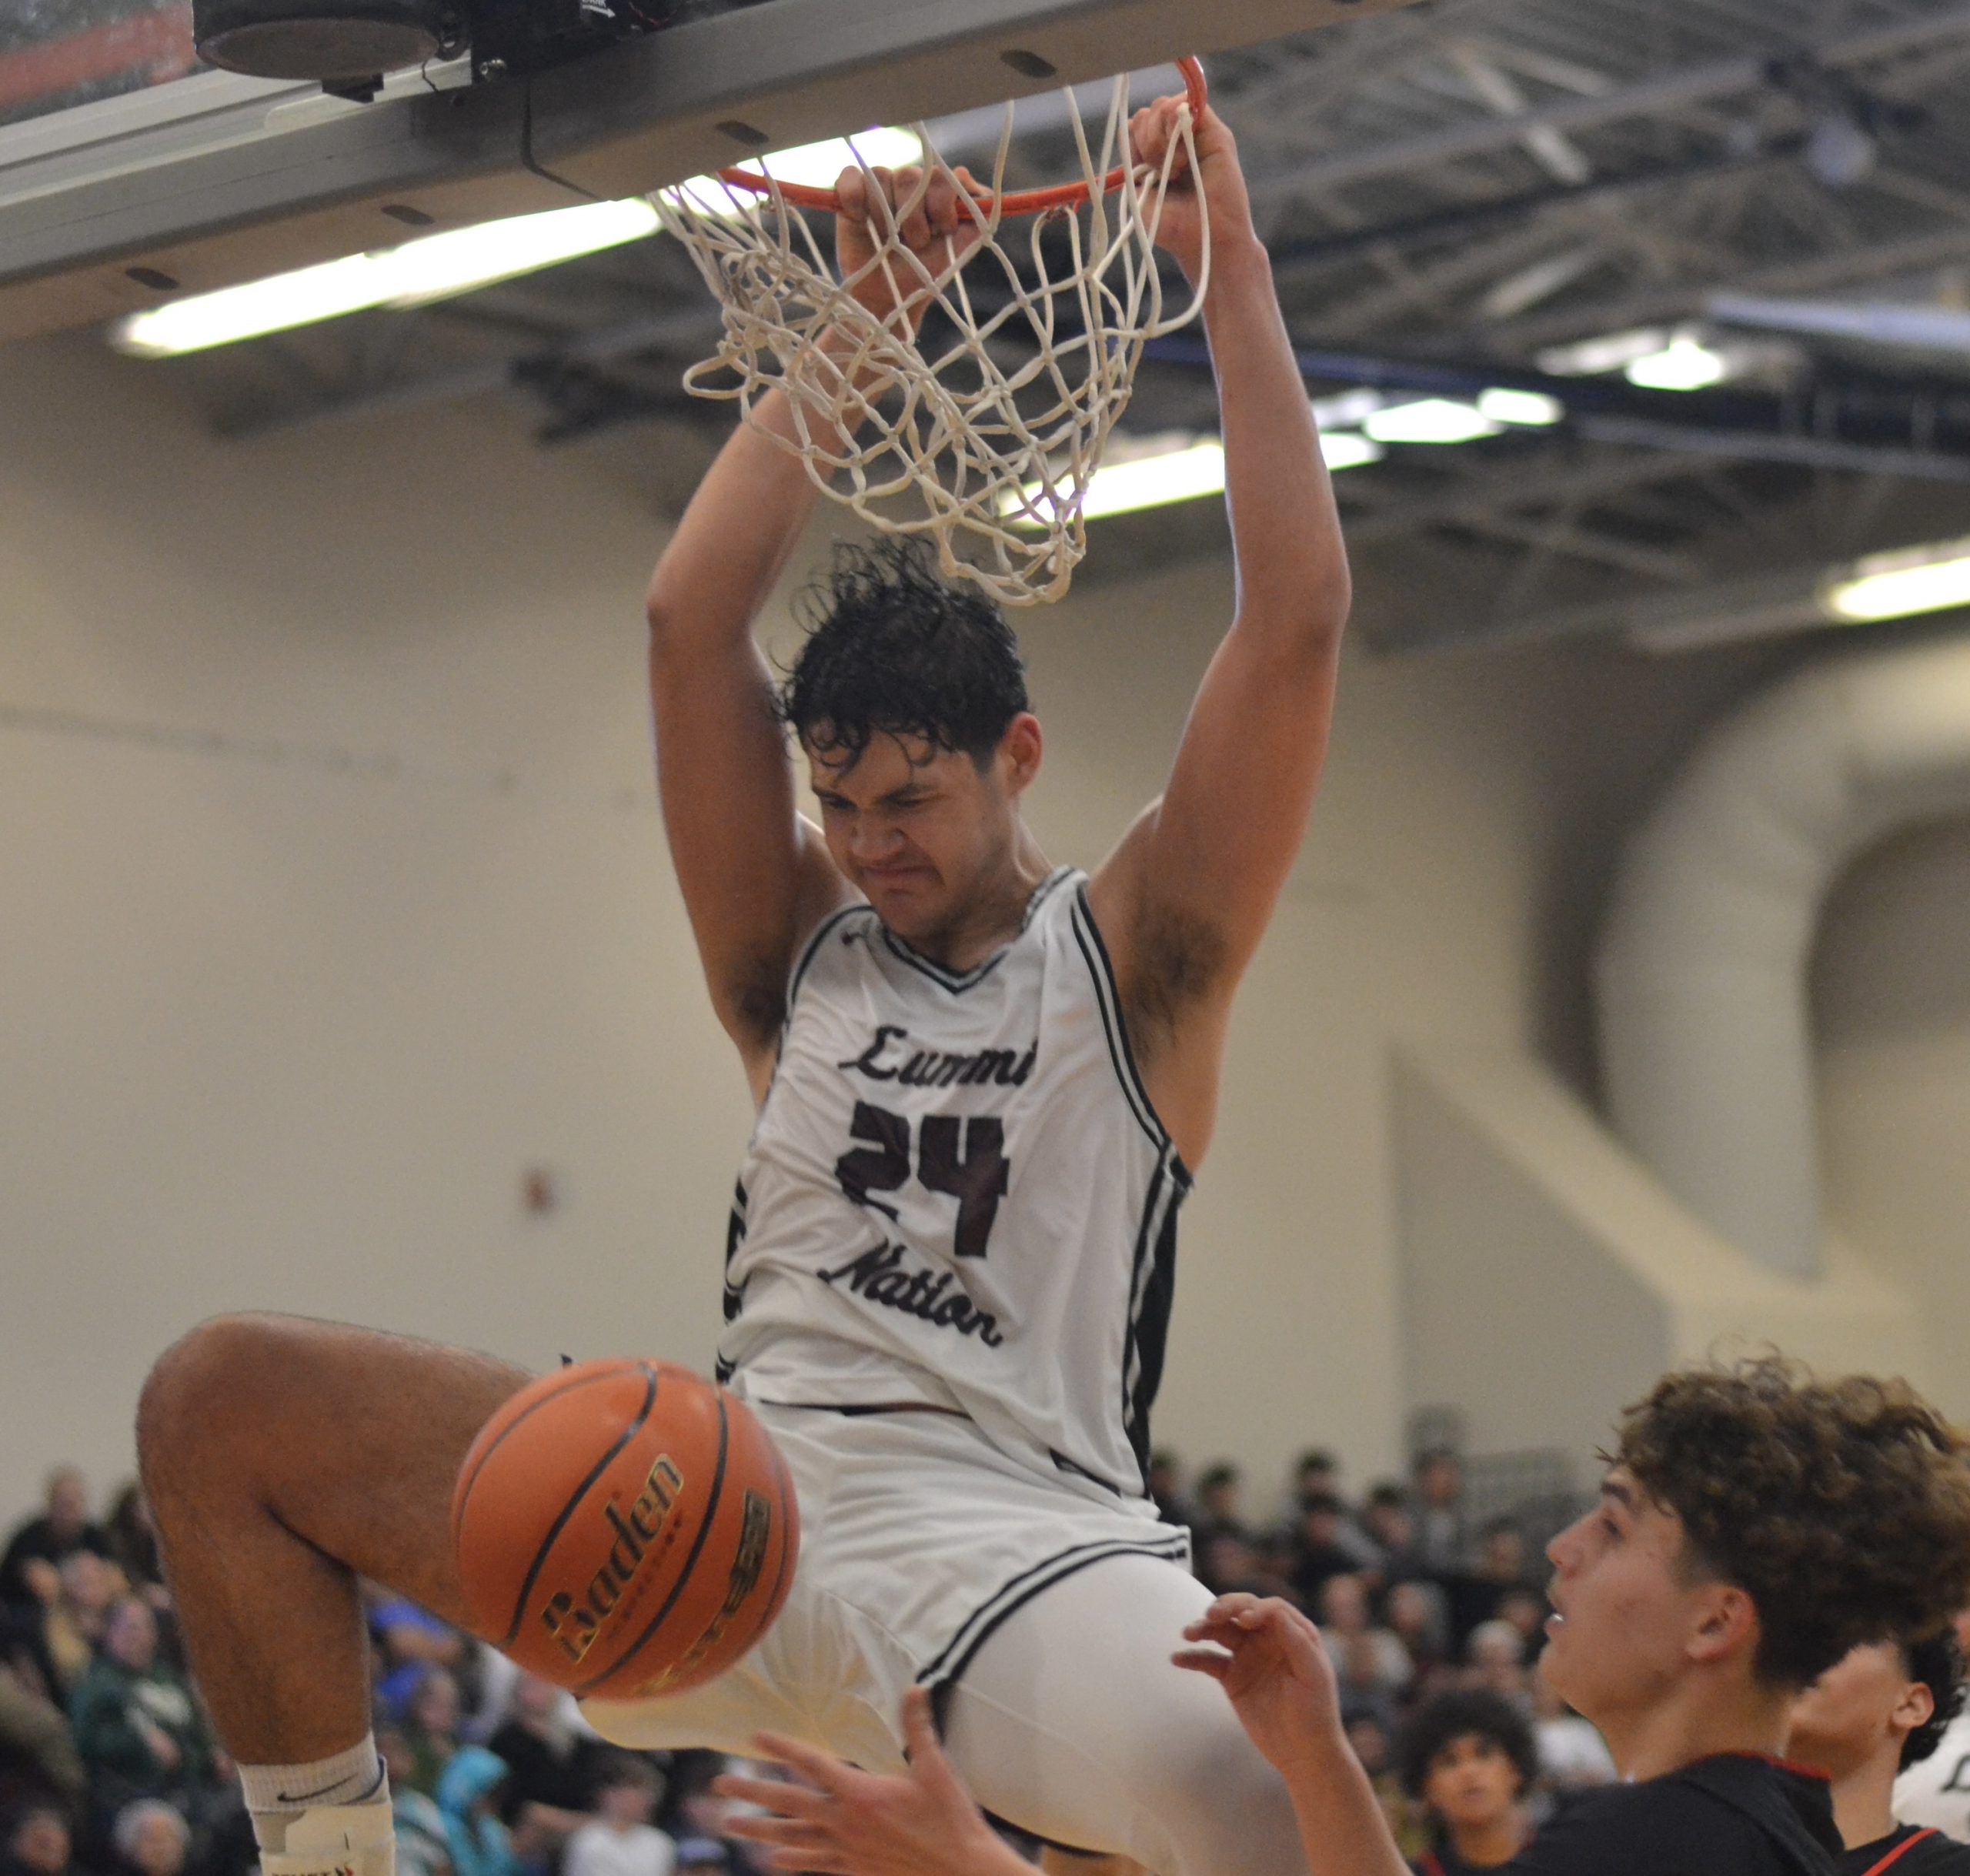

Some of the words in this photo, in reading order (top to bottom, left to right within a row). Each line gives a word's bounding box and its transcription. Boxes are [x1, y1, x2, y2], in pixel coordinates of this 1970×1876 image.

[835, 1100, 1010, 1258] 24
[816, 1237, 1003, 1348] Nation
[540, 1453, 684, 1665] Baden
